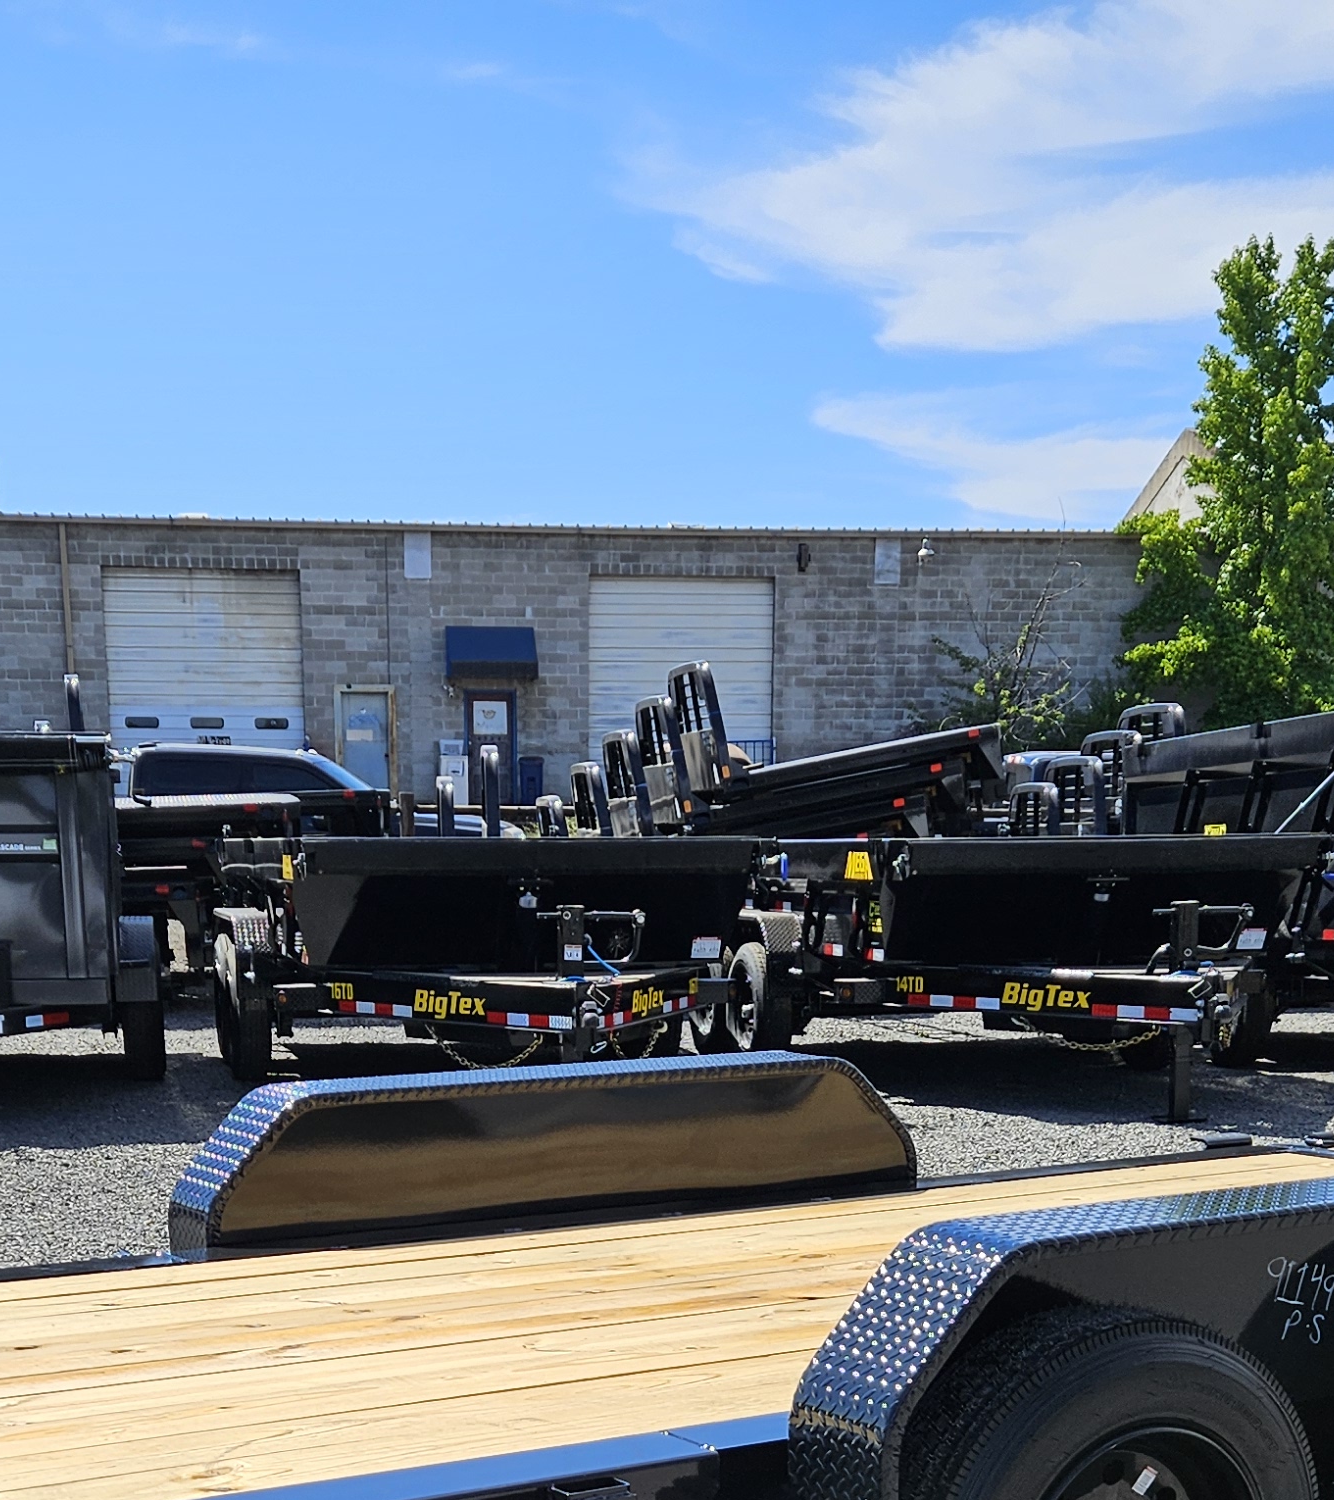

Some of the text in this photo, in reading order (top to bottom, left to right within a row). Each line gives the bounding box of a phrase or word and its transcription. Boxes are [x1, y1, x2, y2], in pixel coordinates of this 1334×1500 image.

[329, 982, 355, 1000] 16TD
[895, 975, 924, 993] 14TD
[1001, 981, 1092, 1012] BigTex
[413, 988, 487, 1020] BigTex
[631, 986, 665, 1017] BigTex
